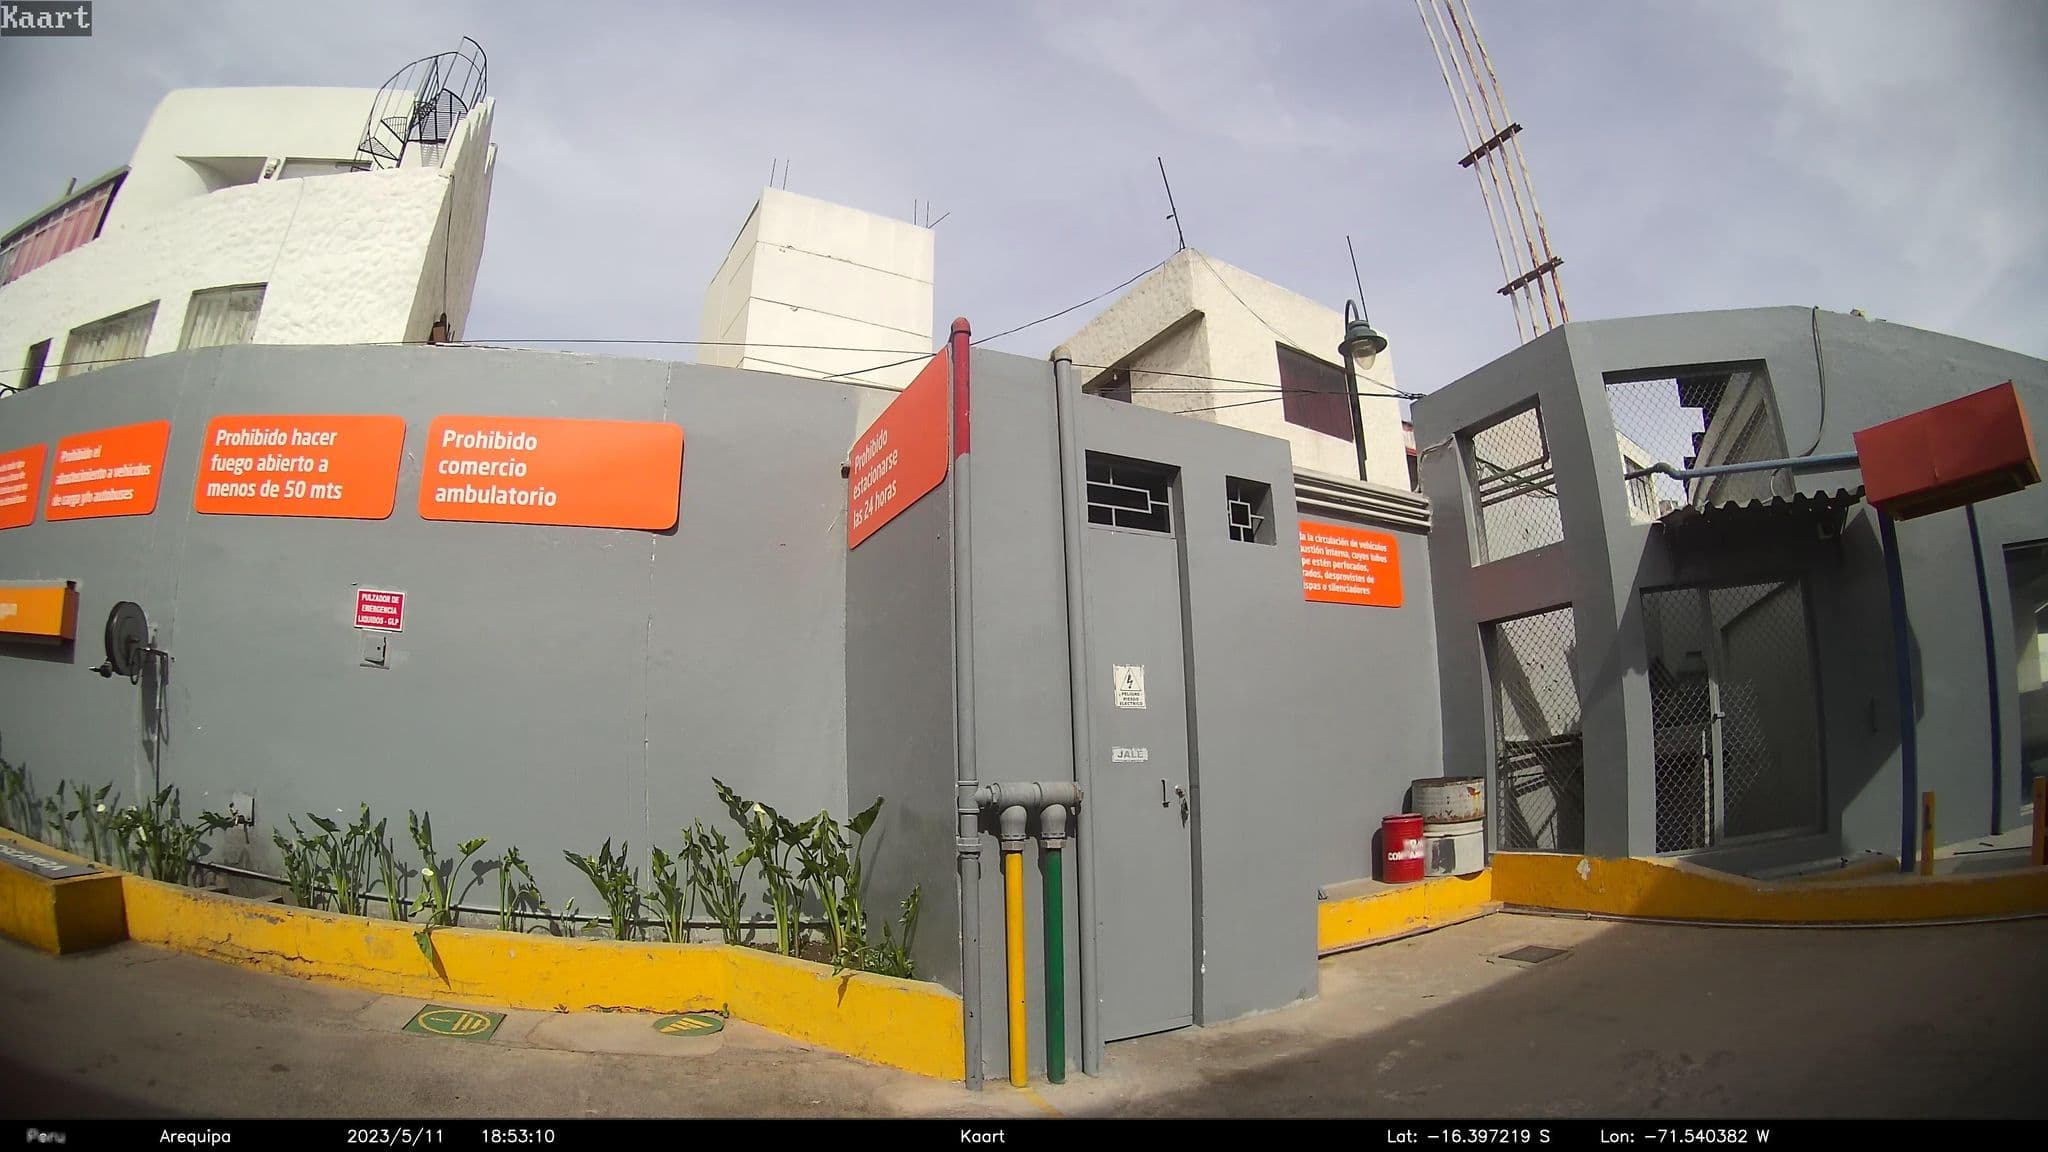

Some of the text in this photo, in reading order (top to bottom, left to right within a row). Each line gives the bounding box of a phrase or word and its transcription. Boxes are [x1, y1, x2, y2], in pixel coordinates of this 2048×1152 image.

[215, 428, 338, 447] Prohibido hacer
[442, 429, 538, 451] Prohibido
[854, 429, 888, 475] Prohibido
[210, 454, 329, 476] fuego abierto a
[438, 458, 527, 477] comercio
[853, 448, 898, 501] estacionarse
[206, 480, 343, 500] menos de 50 mts
[435, 485, 557, 507] ambulatorio
[853, 480, 897, 529] las 24 horas
[1117, 750, 1144, 759] JALE
